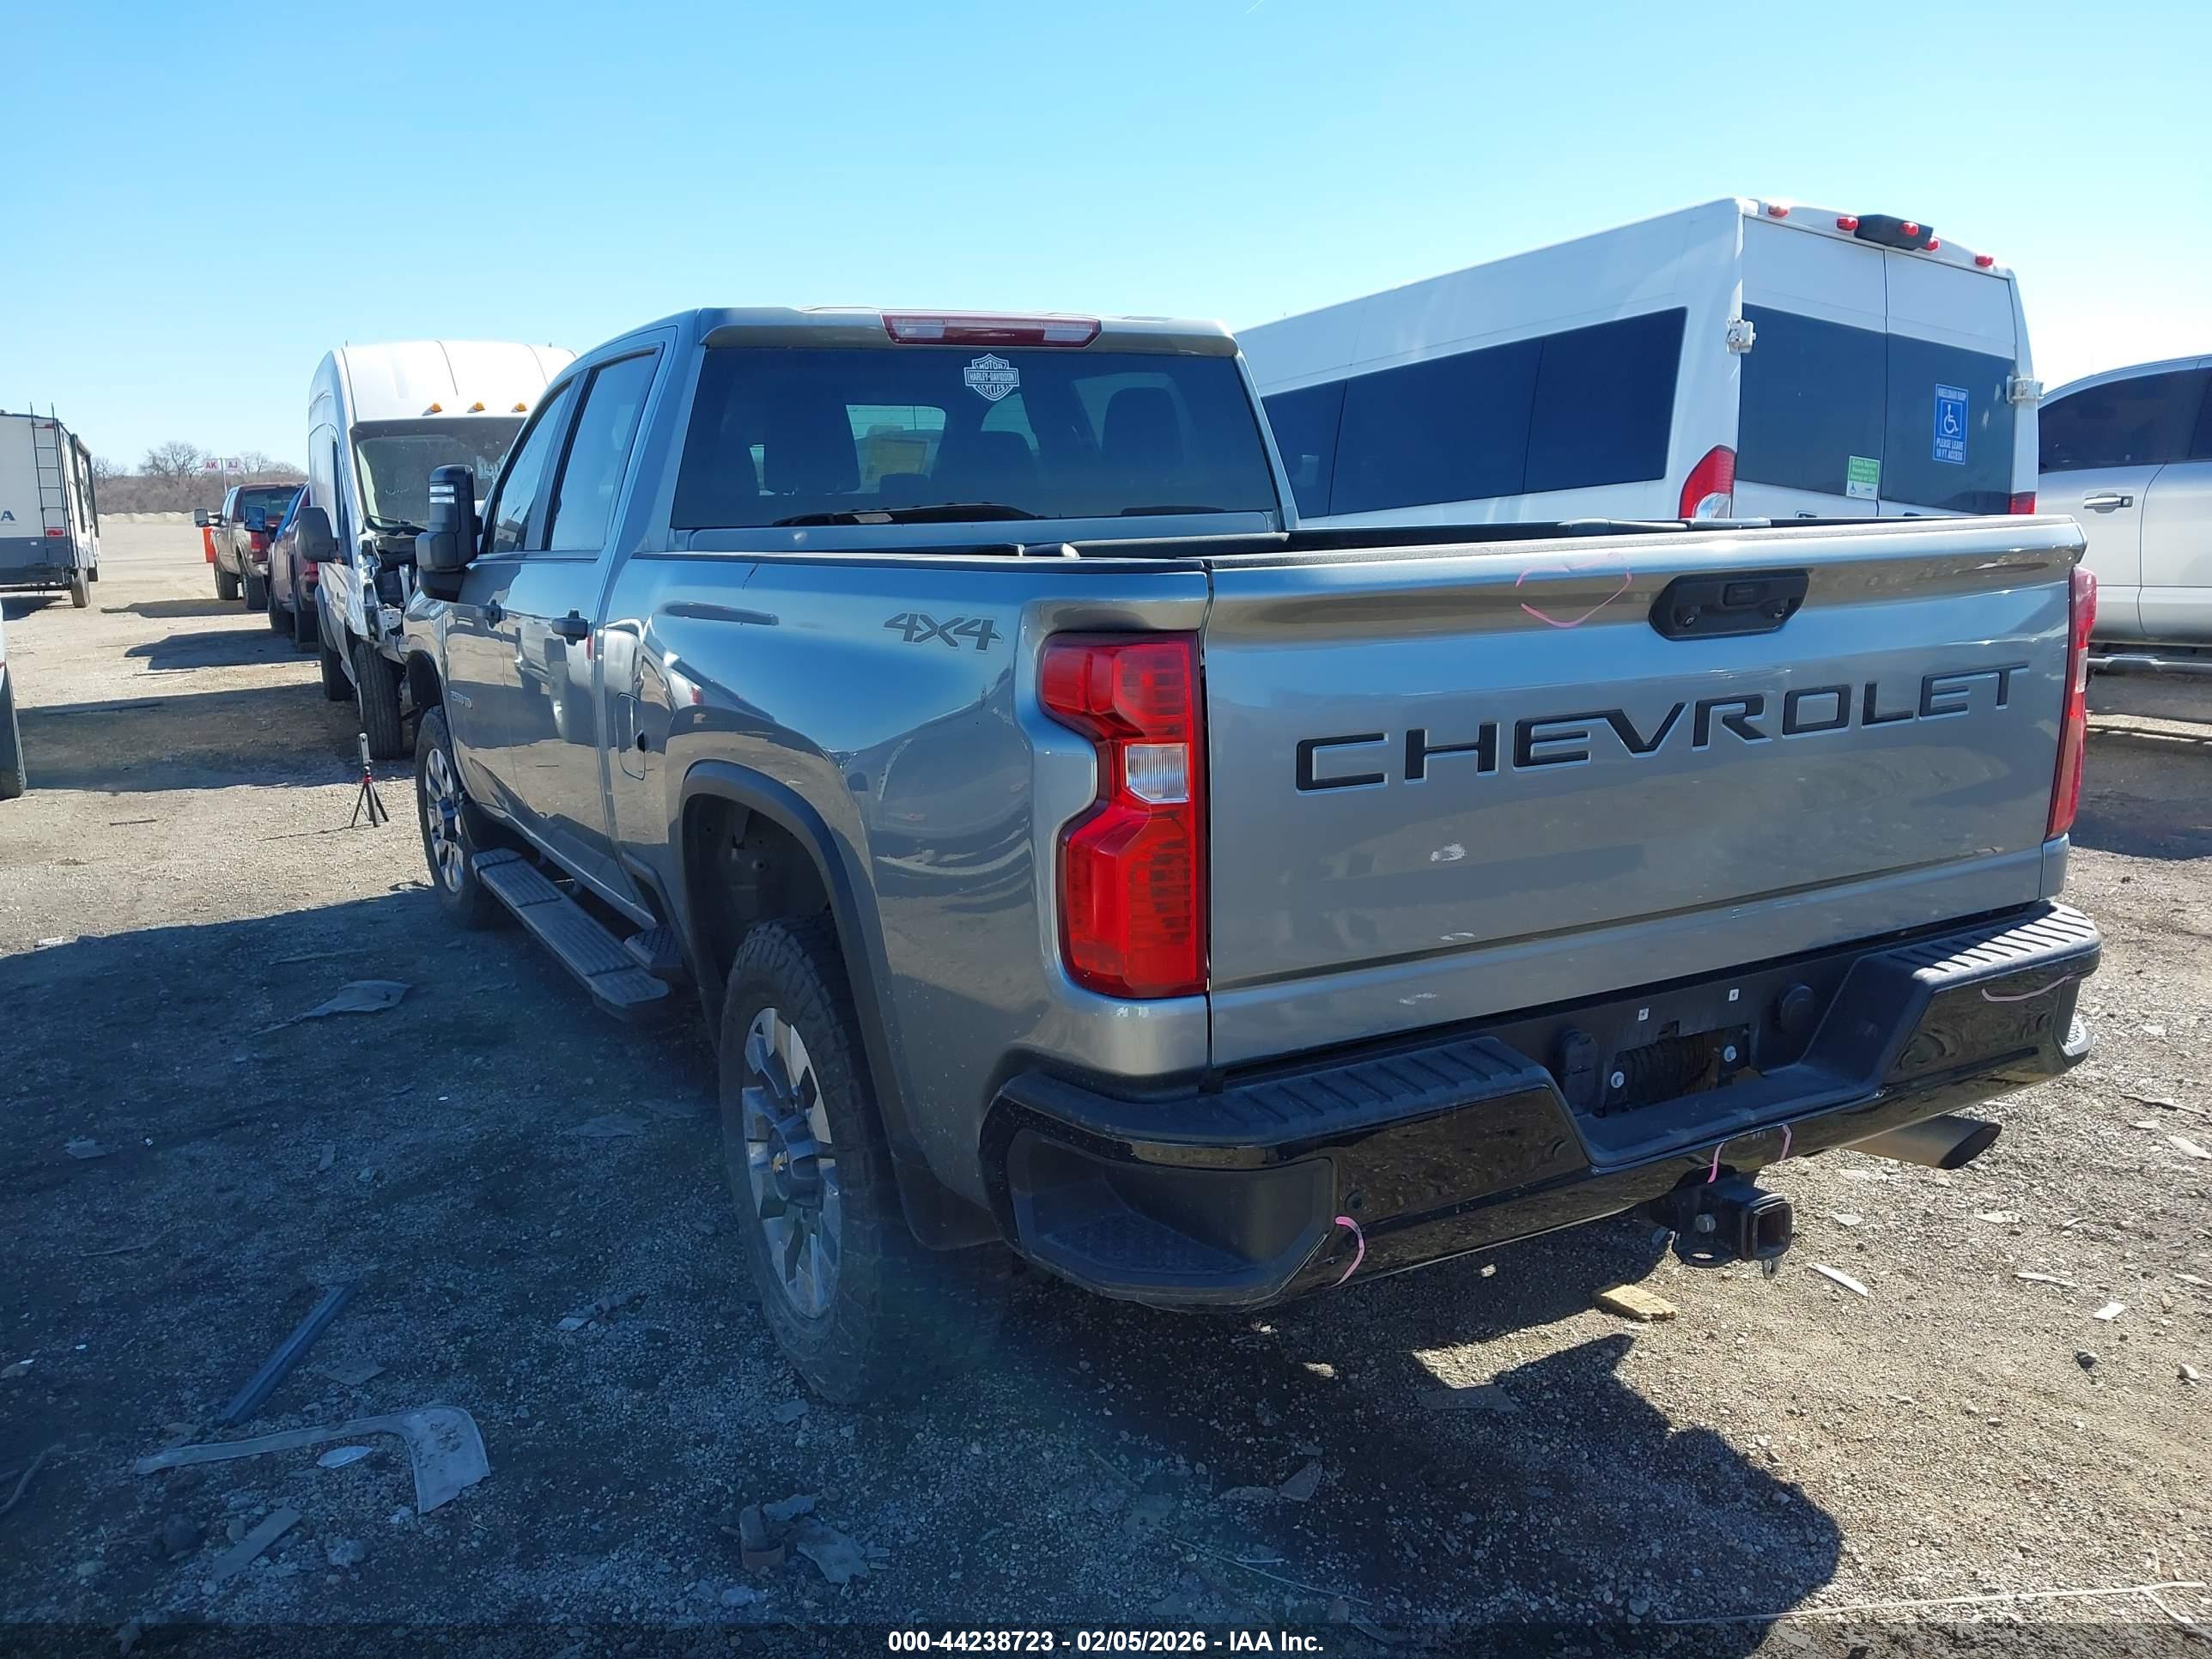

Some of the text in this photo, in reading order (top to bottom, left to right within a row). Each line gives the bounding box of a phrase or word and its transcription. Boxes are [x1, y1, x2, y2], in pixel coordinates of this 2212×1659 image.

[978, 360, 1003, 370] MOTOR
[969, 372, 1015, 382] HARLEY-DAVIDSON
[981, 385, 1006, 395] CYCLES
[1296, 661, 2030, 794] CHEVROLET
